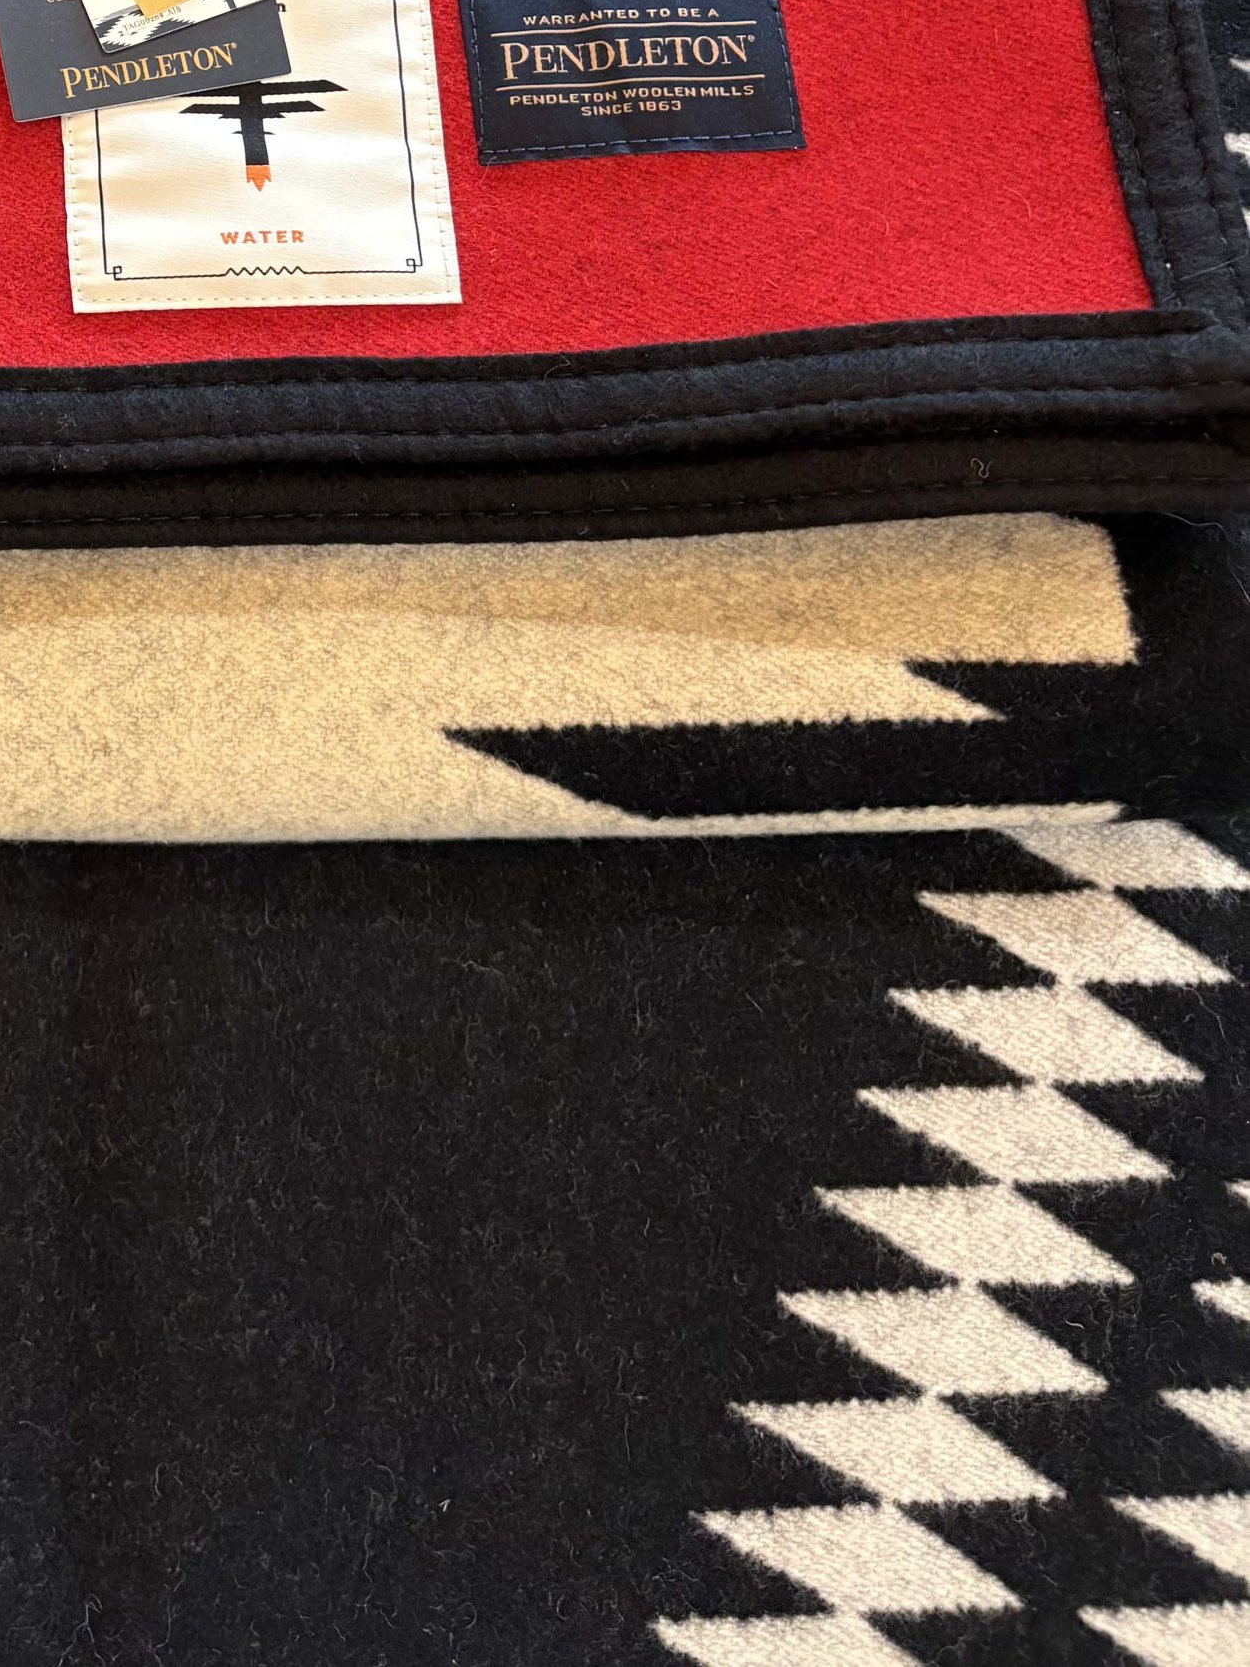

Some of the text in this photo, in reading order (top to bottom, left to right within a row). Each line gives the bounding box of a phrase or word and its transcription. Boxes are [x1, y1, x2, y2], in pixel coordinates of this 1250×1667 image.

[523, 7, 720, 26] WARRANTED TO BE A
[509, 85, 755, 106] PENDLETON WOOLEN MILLS
[581, 100, 682, 117] SINCE 1863
[220, 229, 304, 245] WATER
